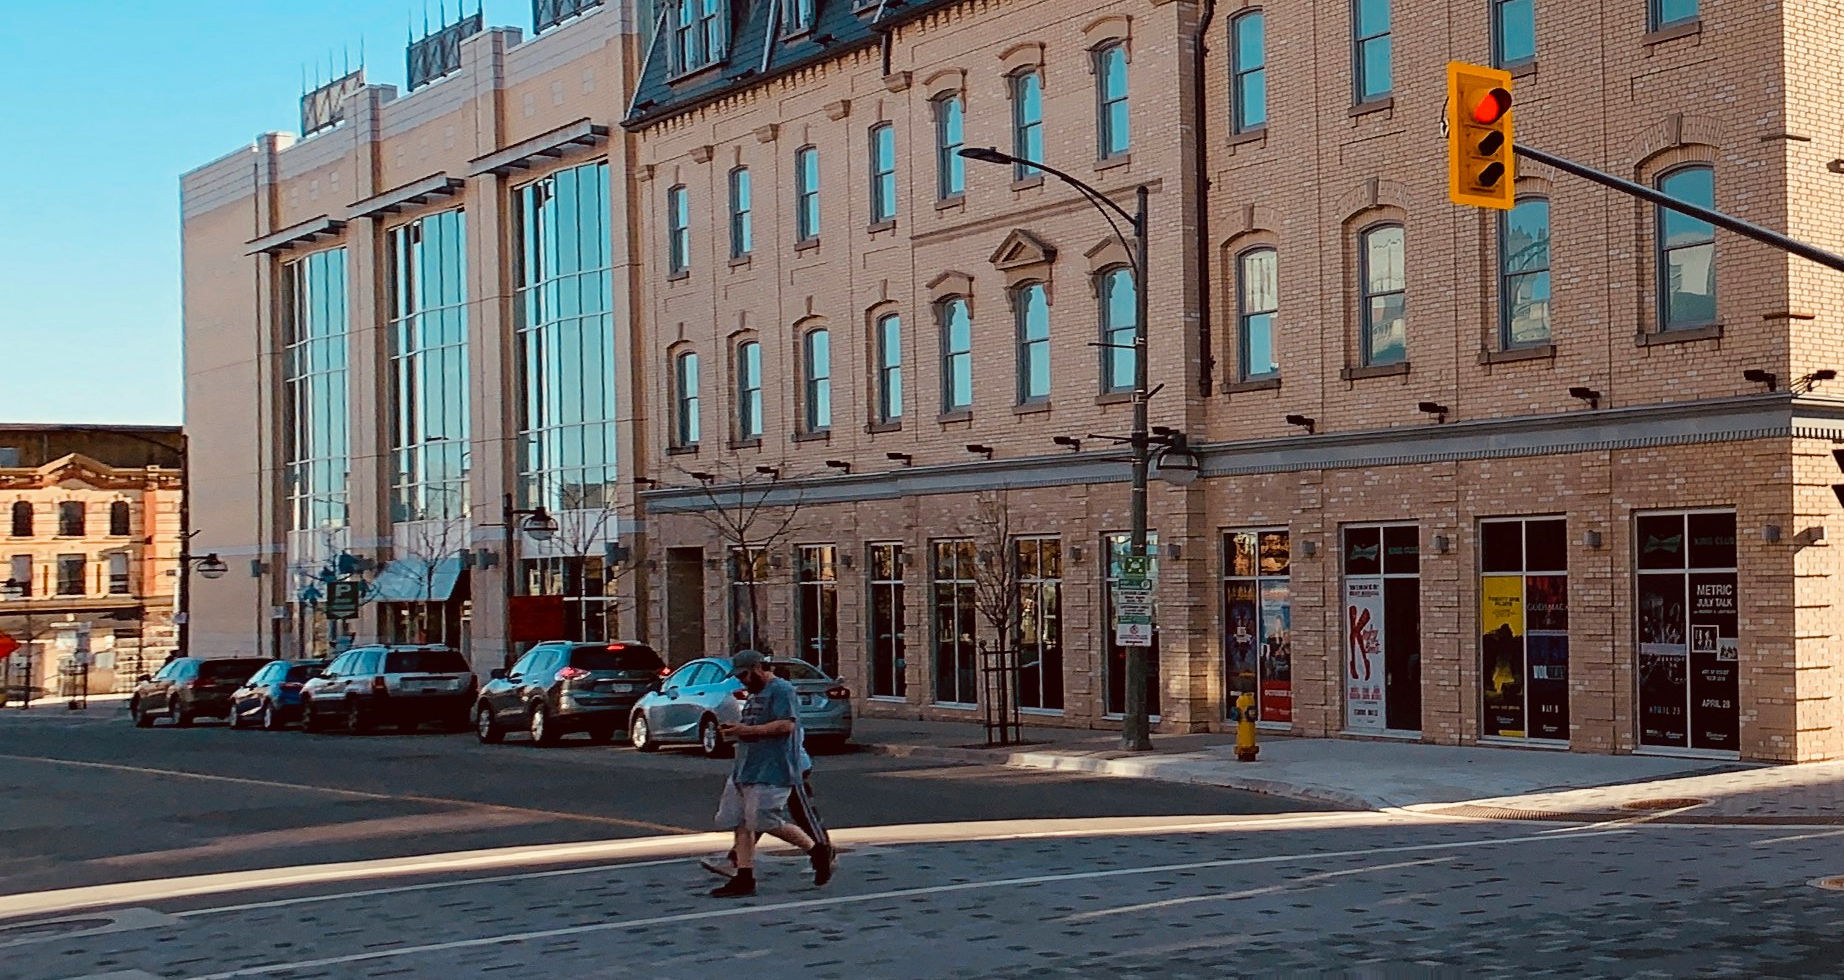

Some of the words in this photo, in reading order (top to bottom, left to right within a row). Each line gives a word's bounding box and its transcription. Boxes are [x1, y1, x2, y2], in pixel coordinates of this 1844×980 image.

[335, 584, 352, 596] P
[1696, 584, 1733, 596] METRIC
[1696, 598, 1714, 607] JULY
[1715, 598, 1733, 607] TALK
[1701, 699, 1721, 708] APRIL
[1648, 705, 1669, 715] APRIL
